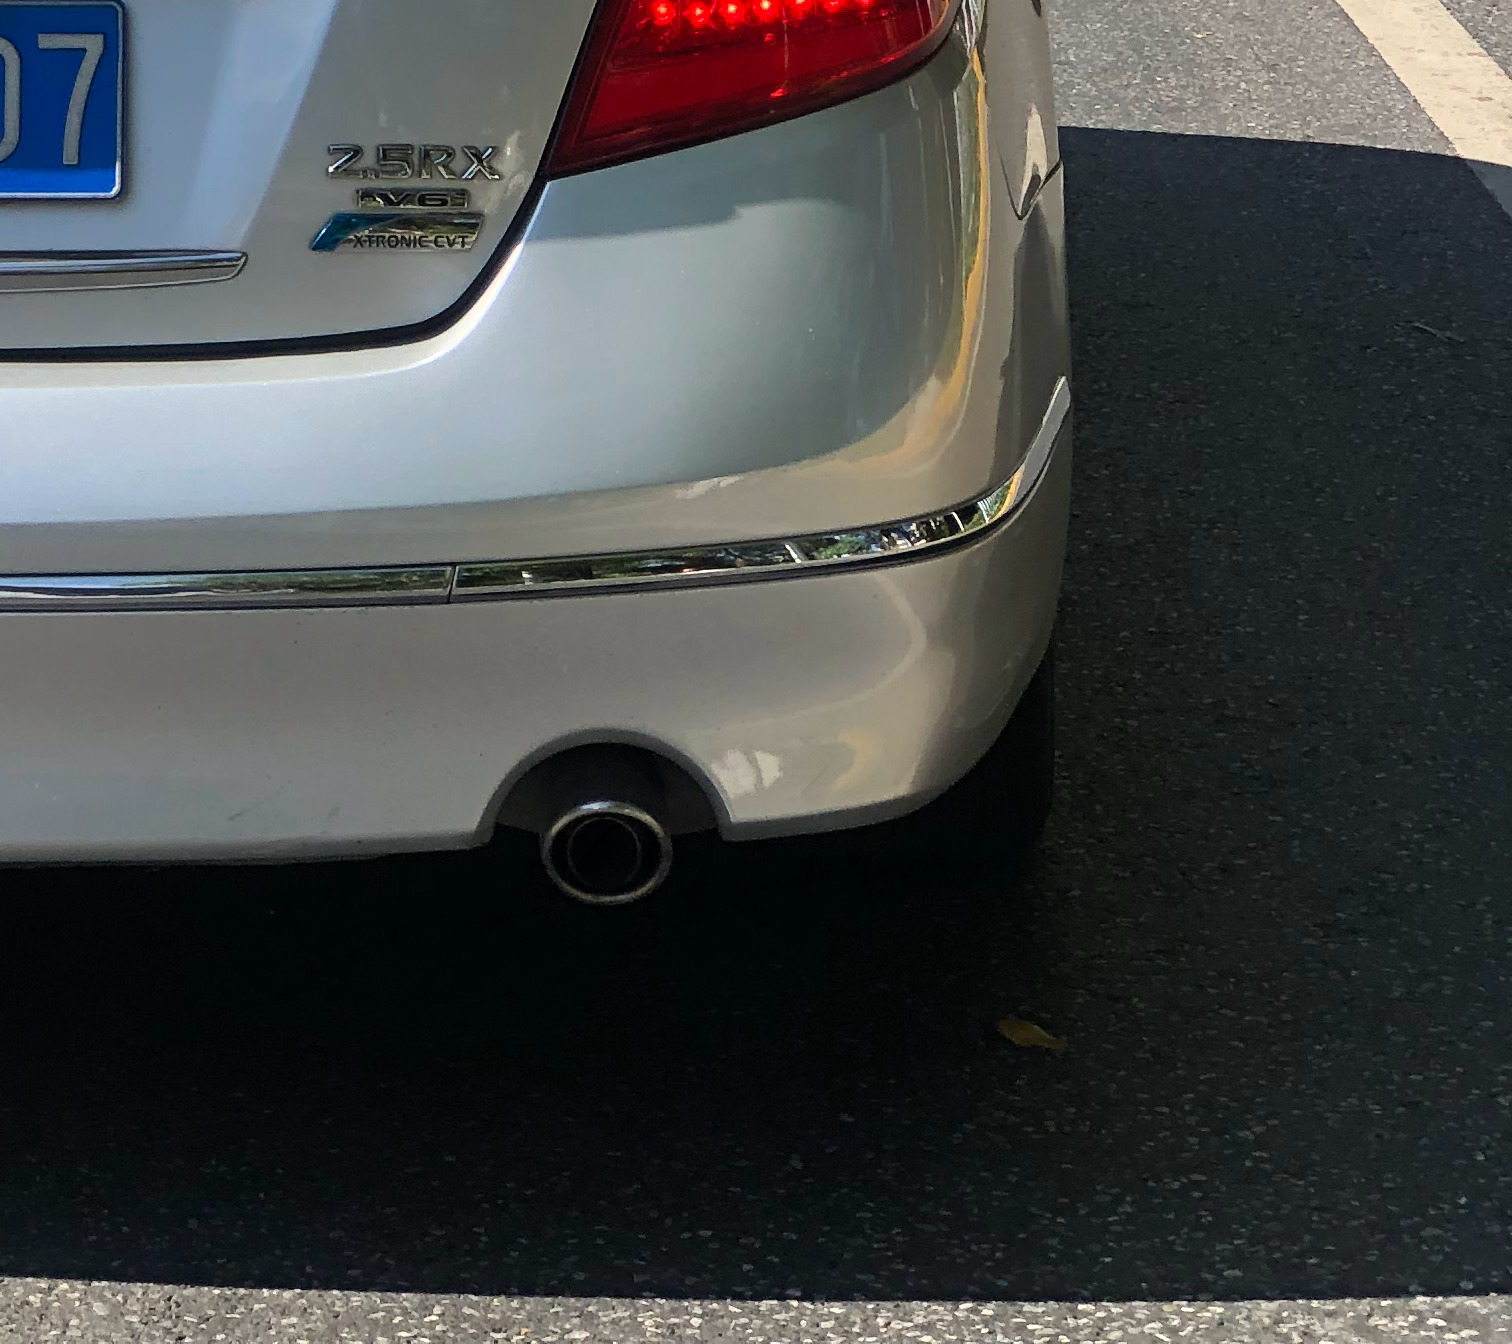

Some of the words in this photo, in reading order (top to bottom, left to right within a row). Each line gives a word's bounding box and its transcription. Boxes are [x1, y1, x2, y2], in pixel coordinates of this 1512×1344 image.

[327, 143, 501, 180] 2.5RX
[352, 235, 429, 249] XTRONIC
[433, 235, 469, 249] CVT
